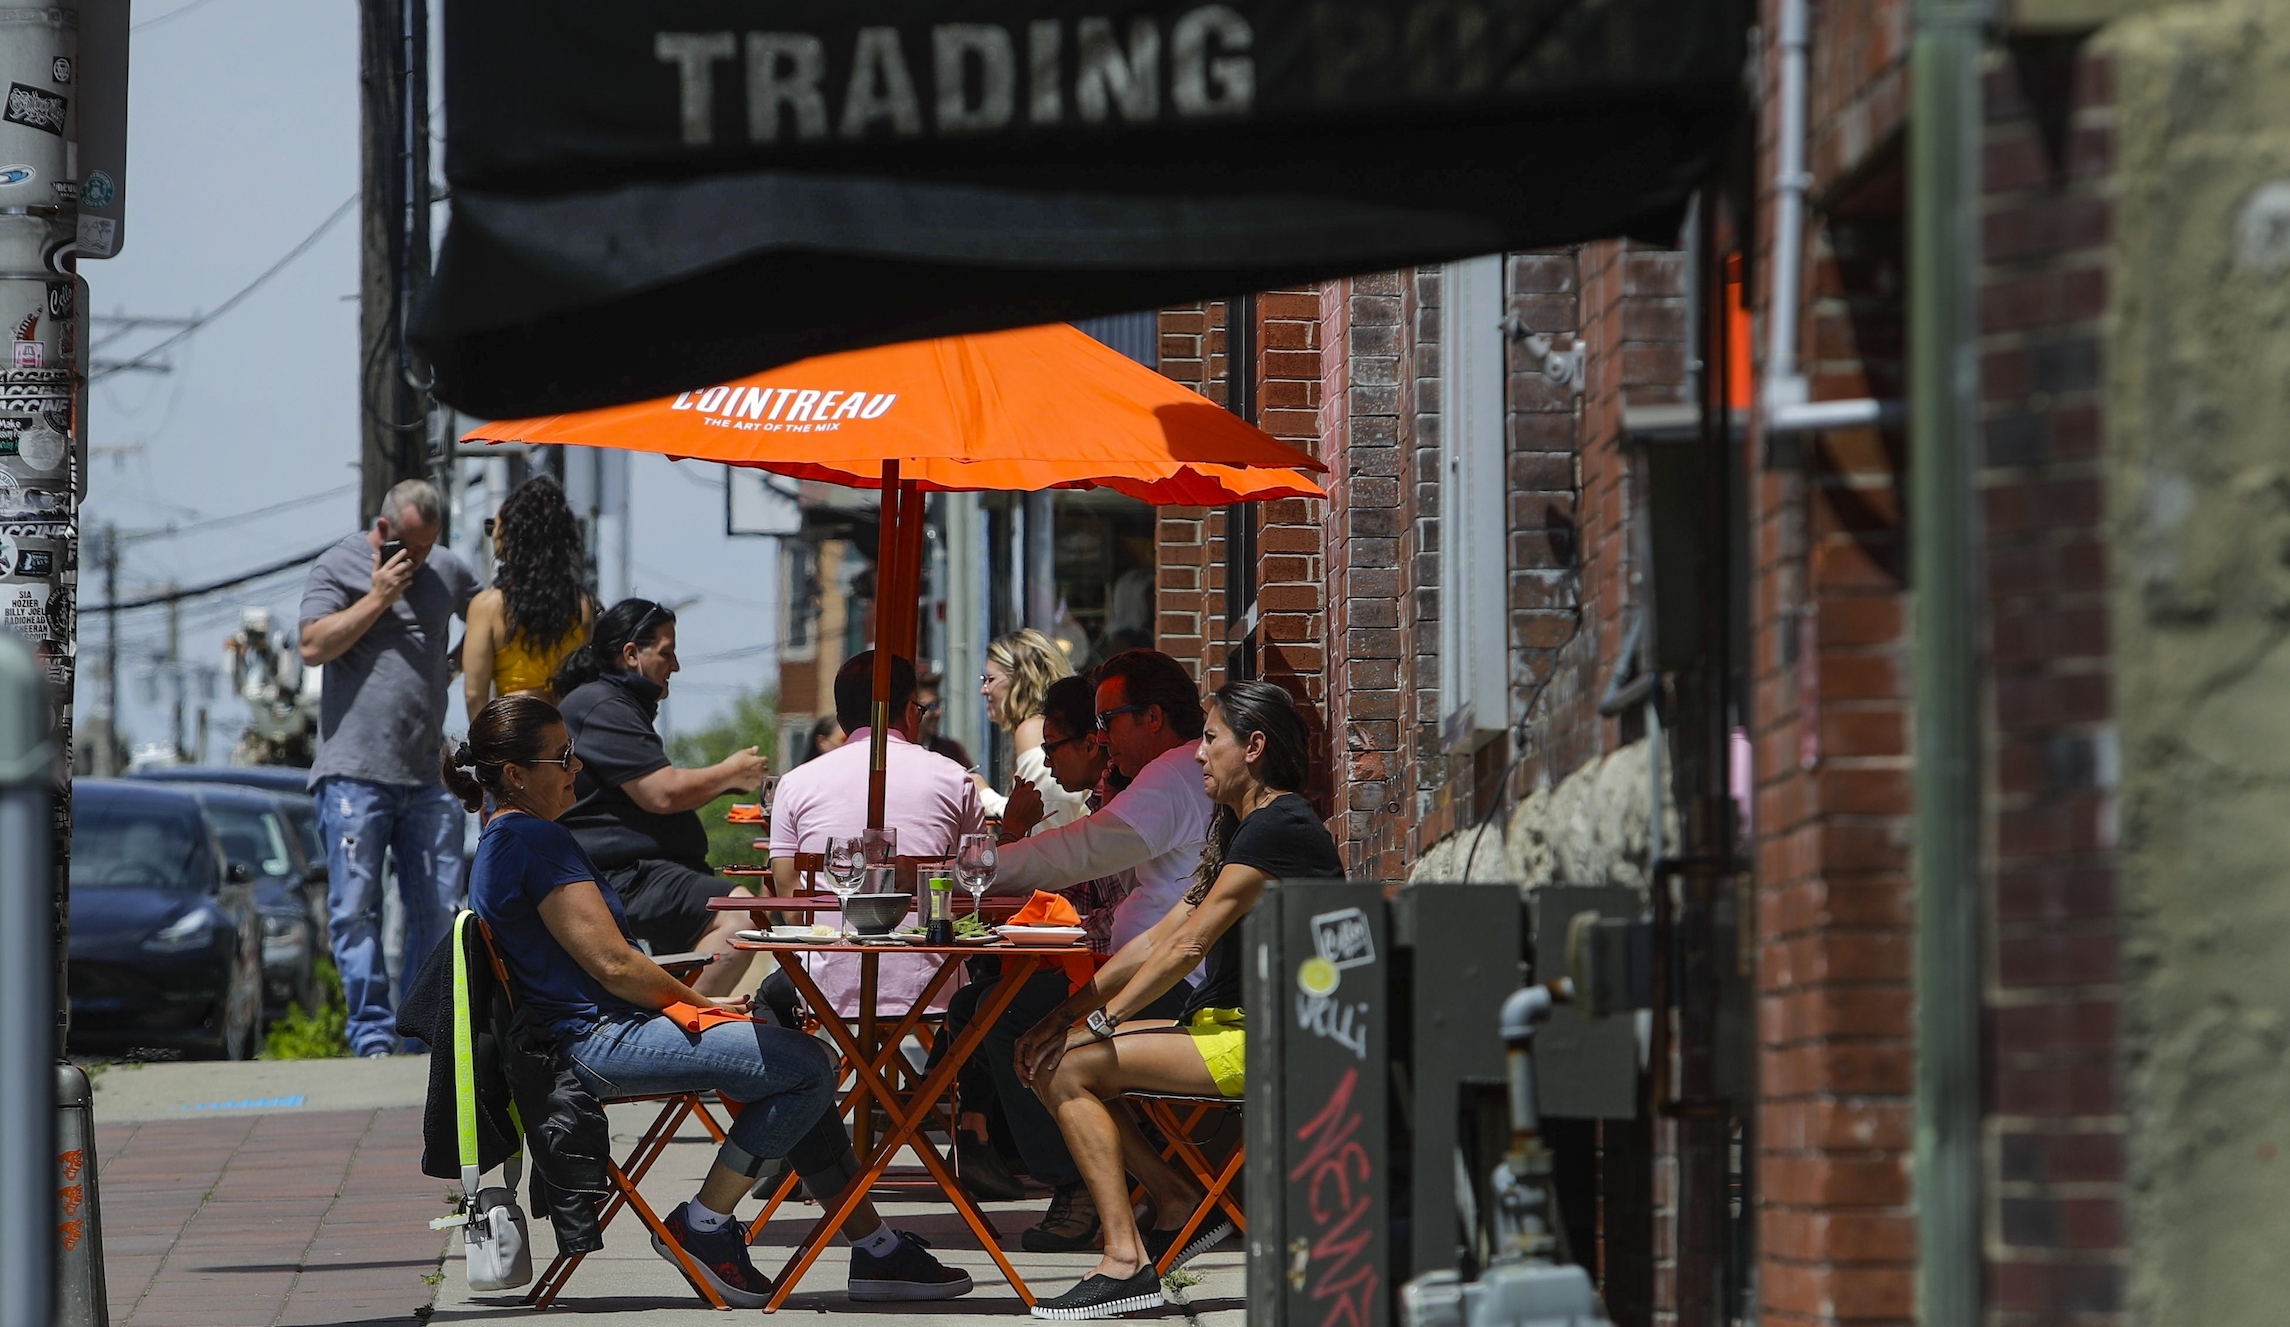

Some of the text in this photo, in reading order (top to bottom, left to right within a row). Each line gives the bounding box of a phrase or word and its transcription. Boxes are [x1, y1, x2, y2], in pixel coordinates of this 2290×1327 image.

[656, 6, 1256, 145] TRADING
[703, 417, 841, 433] THE ART OF THE MIX
[19, 590, 32, 599] SIA
[12, 599, 39, 608] HOZIER
[5, 607, 46, 616] BILLY JOEL
[4, 616, 46, 625] RADIOHEAD
[460, 1059, 470, 1086] KORS
[464, 1136, 474, 1162] KORS
